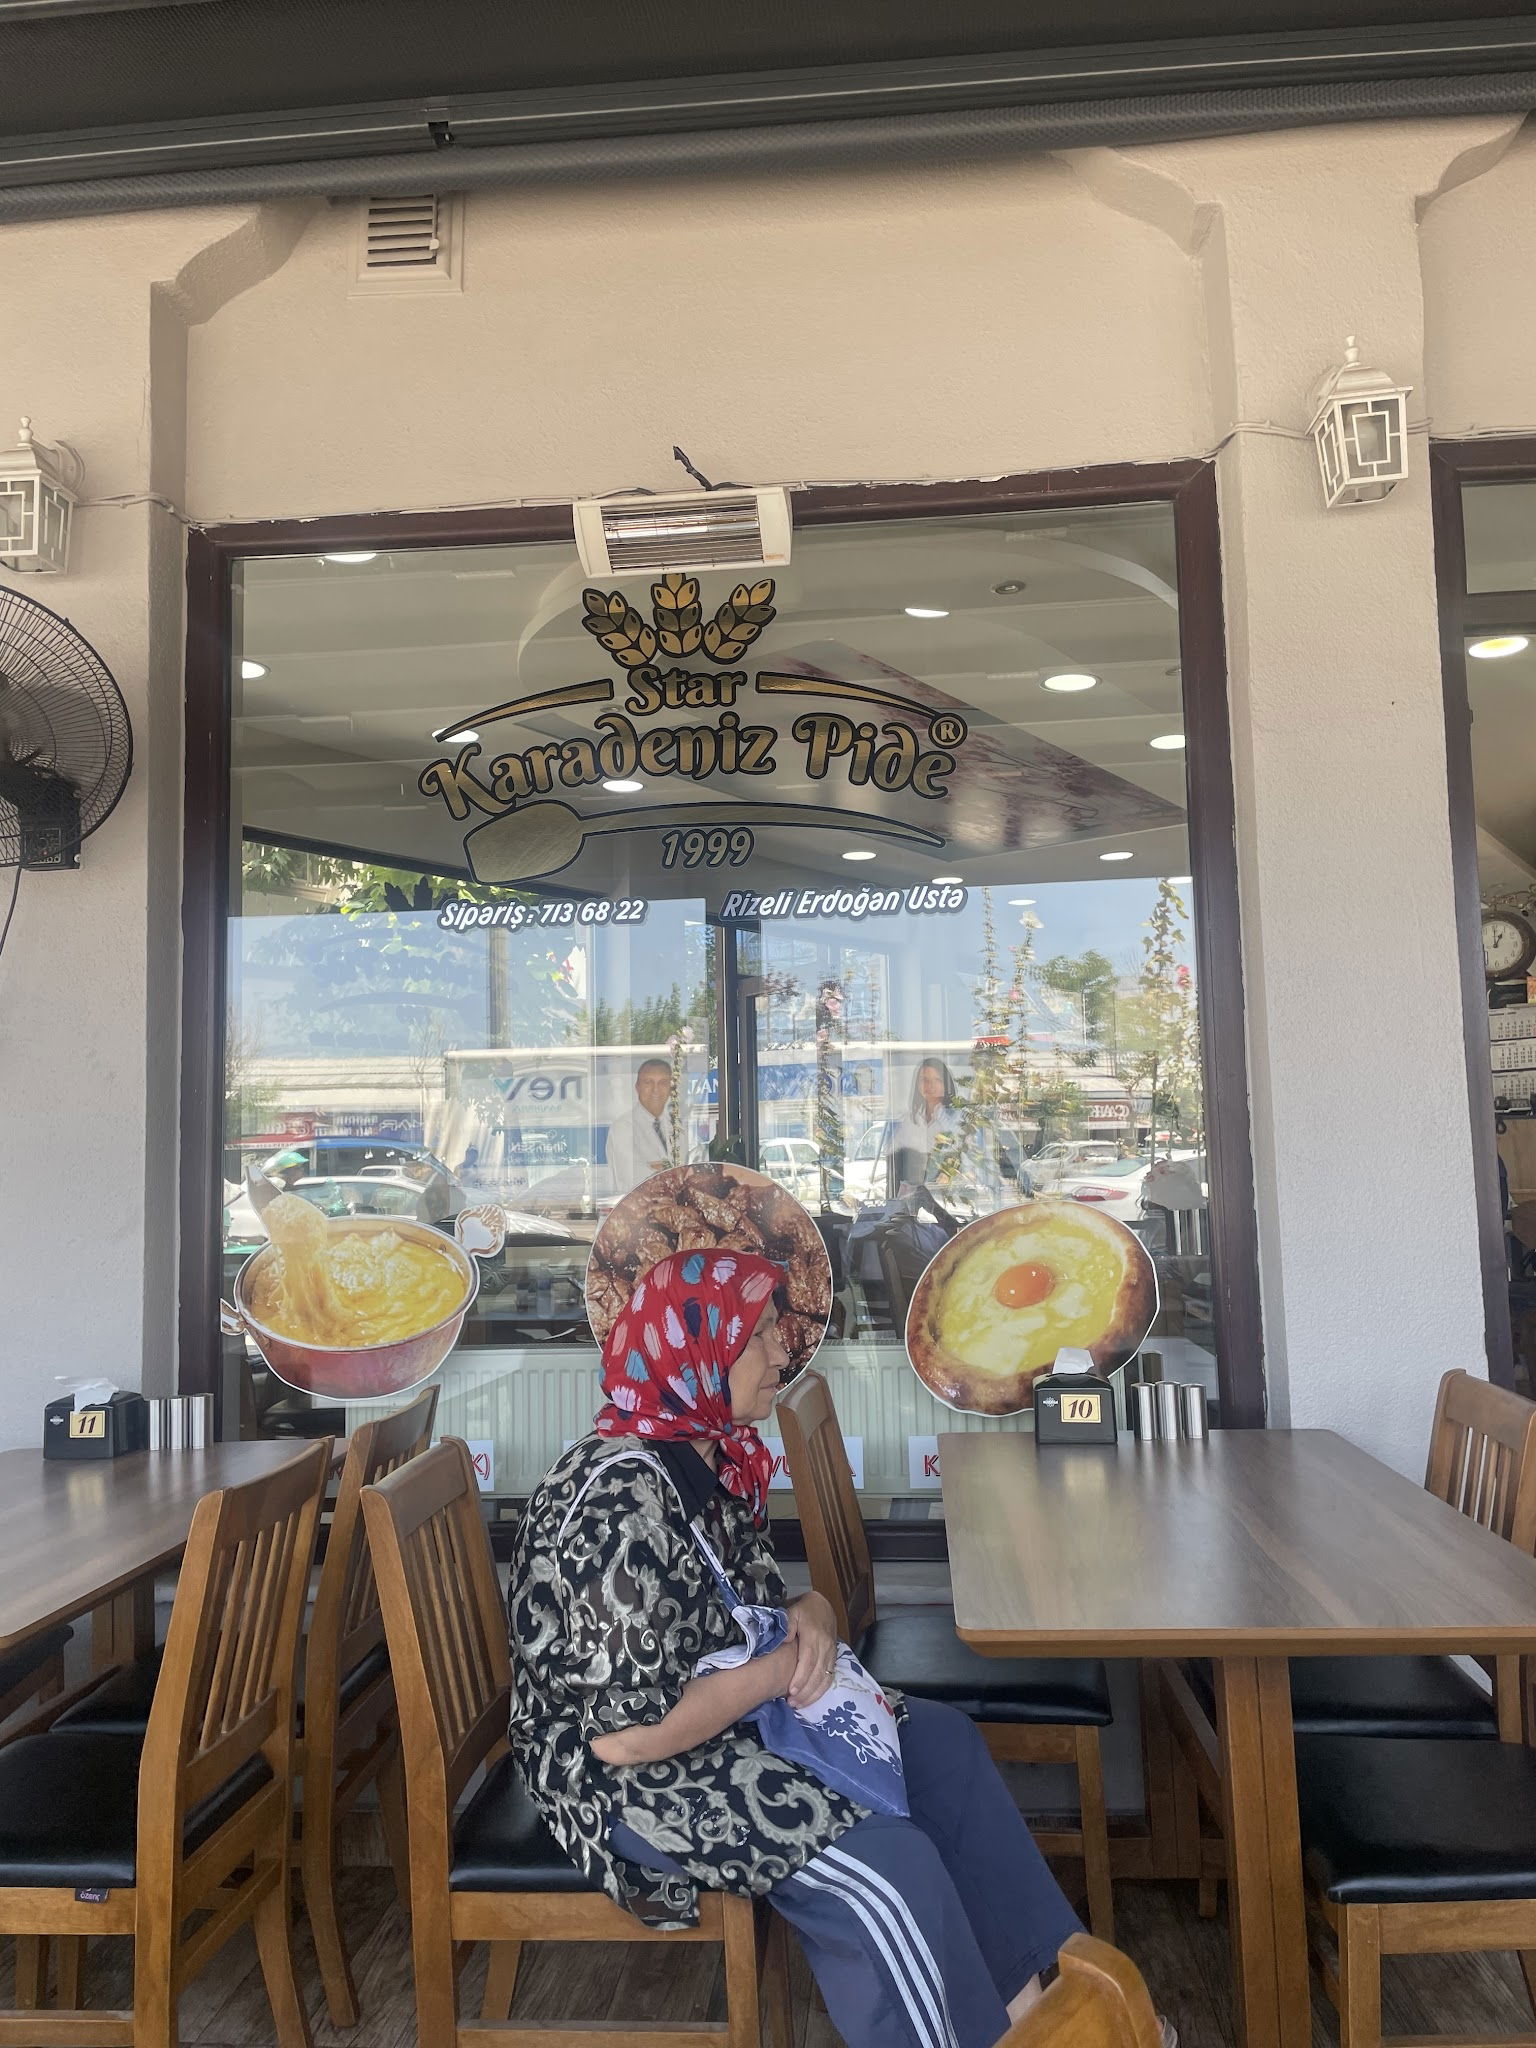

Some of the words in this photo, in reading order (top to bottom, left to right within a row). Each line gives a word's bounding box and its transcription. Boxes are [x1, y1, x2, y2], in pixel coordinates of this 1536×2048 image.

[626, 665, 747, 716] Star
[418, 711, 778, 820] Karadeniz
[792, 712, 956, 799] Pide
[662, 827, 754, 869] 1999
[540, 903, 574, 924] 713
[581, 901, 609, 922] 68
[615, 900, 645, 920] 22
[722, 891, 793, 918] Rizeli
[797, 887, 900, 917] Erdoğan
[908, 885, 964, 910] Usta
[78, 1415, 97, 1434] 11
[1068, 1399, 1093, 1419] 10
